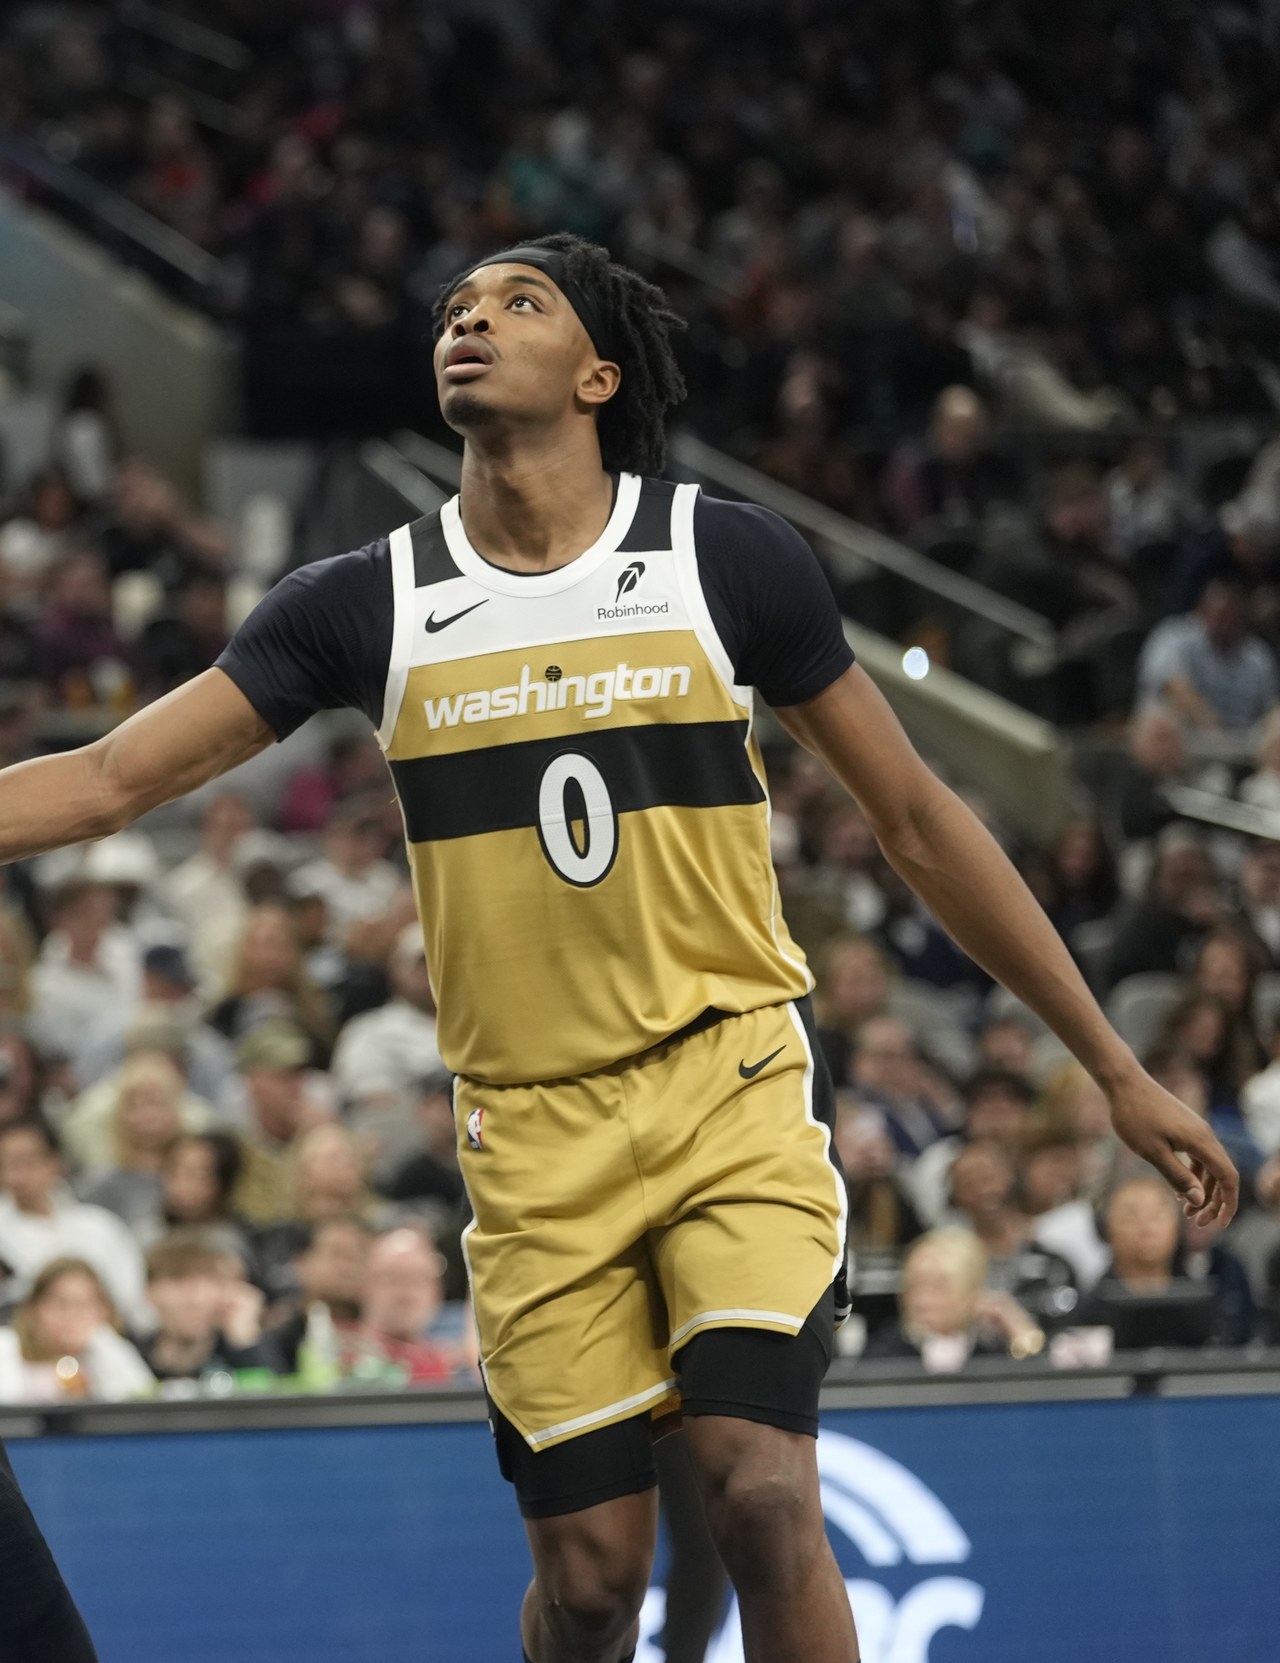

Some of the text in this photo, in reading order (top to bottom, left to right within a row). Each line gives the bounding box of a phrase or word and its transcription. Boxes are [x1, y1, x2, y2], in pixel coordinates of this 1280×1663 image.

[597, 601, 669, 620] Robinhood
[423, 663, 691, 731] washington
[536, 748, 618, 888] 0
